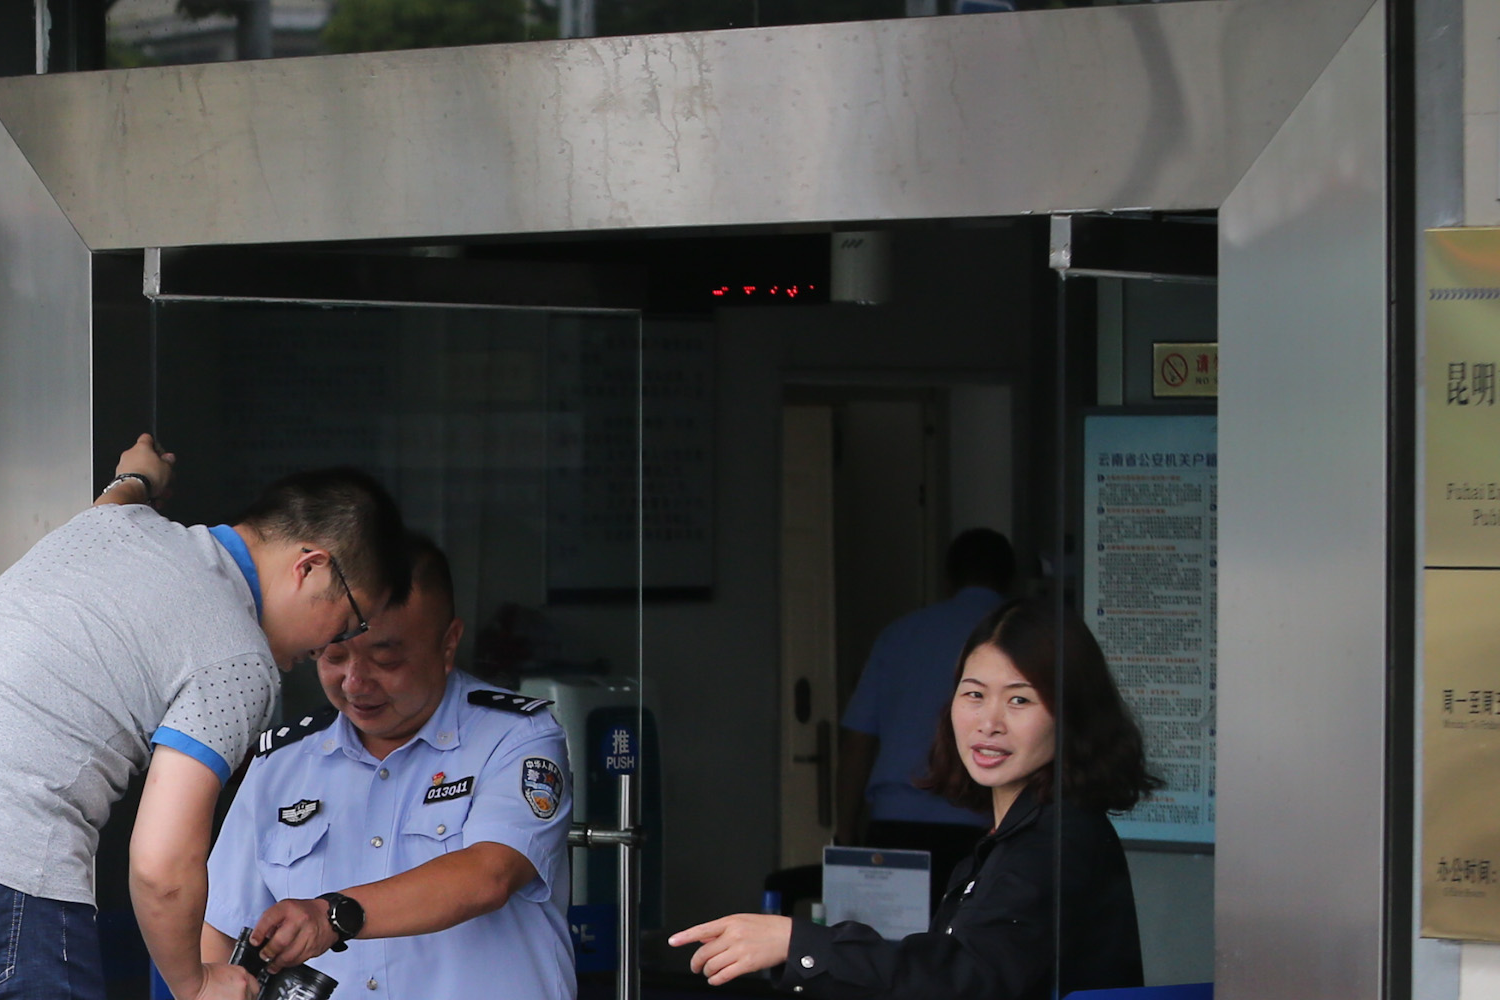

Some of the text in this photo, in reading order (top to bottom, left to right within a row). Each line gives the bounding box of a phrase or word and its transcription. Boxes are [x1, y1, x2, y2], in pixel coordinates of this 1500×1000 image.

[1446, 362, 1500, 406] 昆明
[611, 728, 630, 755] 推
[606, 756, 635, 769] PUSH
[426, 780, 468, 799] 013041
